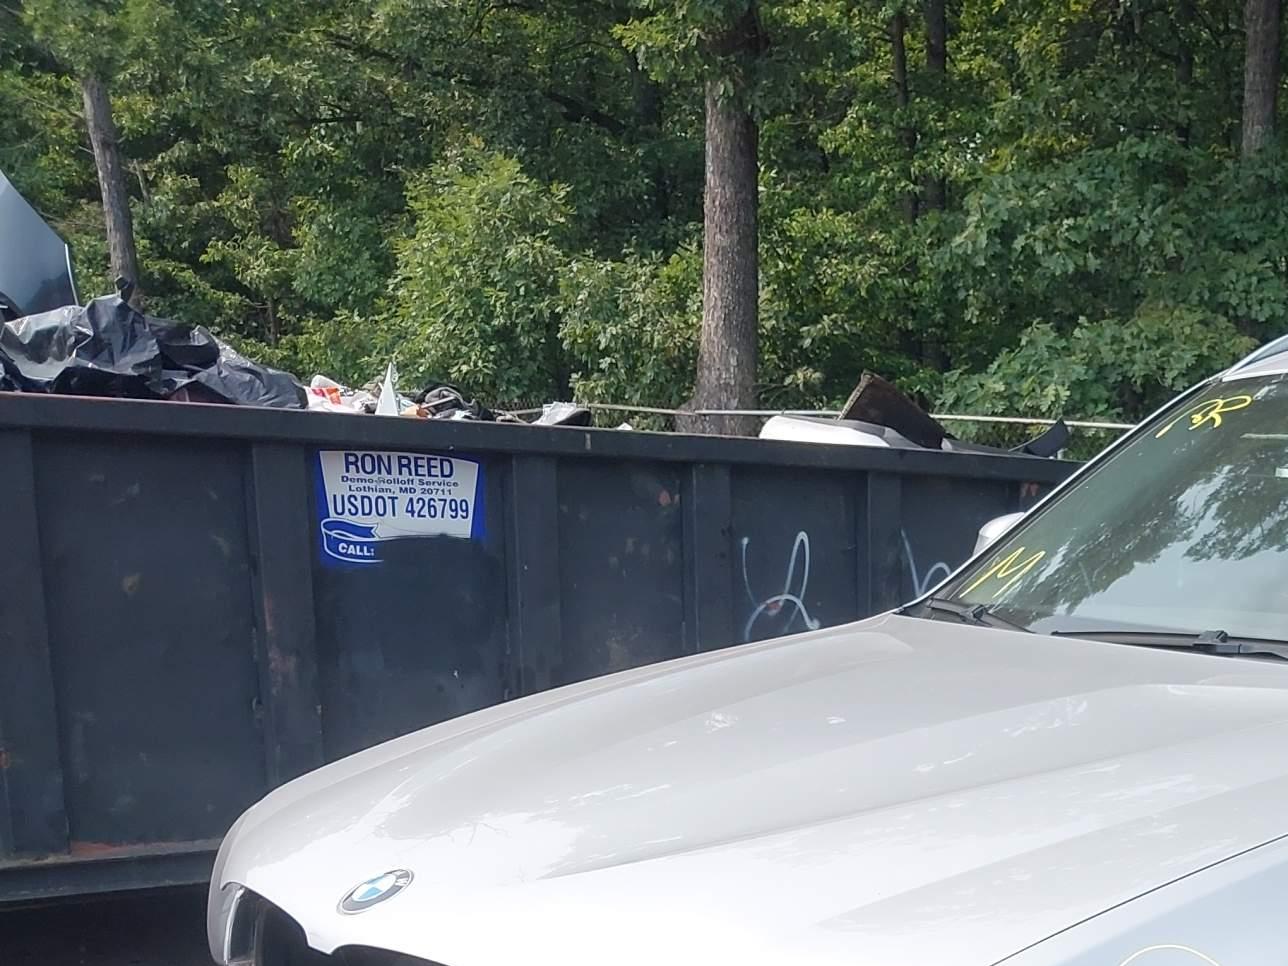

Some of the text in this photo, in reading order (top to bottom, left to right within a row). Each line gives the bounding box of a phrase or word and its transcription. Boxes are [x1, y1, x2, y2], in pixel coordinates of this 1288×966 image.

[344, 453, 454, 478] RON REED
[418, 478, 459, 488] Service
[348, 485, 452, 496] Lothian, MD 20711
[333, 494, 469, 519] USDOT 426799
[338, 542, 375, 556] CALL:
